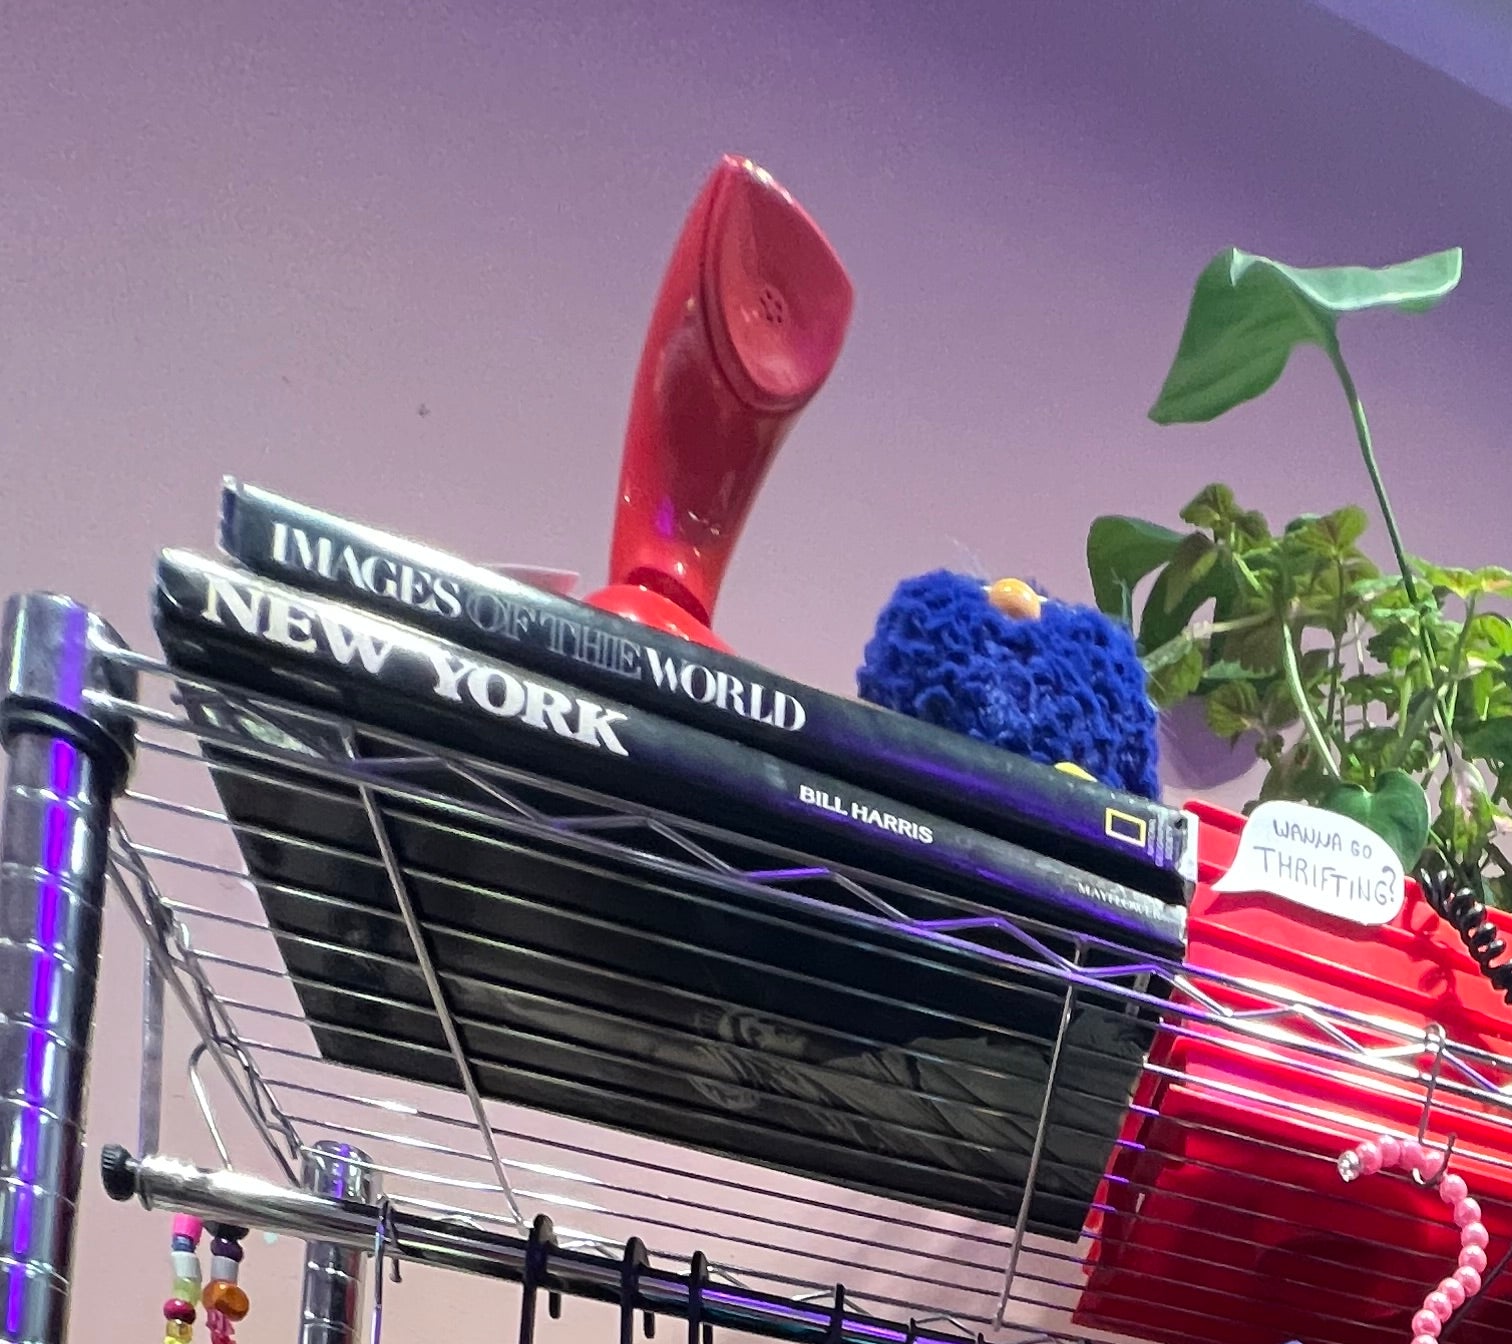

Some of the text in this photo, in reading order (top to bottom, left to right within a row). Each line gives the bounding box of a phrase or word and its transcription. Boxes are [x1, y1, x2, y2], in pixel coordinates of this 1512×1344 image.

[272, 521, 807, 732] IMAGES OF THE WORLD
[201, 573, 630, 758] NEW YORK
[799, 784, 934, 844] BILL HARRIS
[1272, 818, 1373, 860] WANNA GO
[1252, 845, 1397, 906] THRIFTING?
